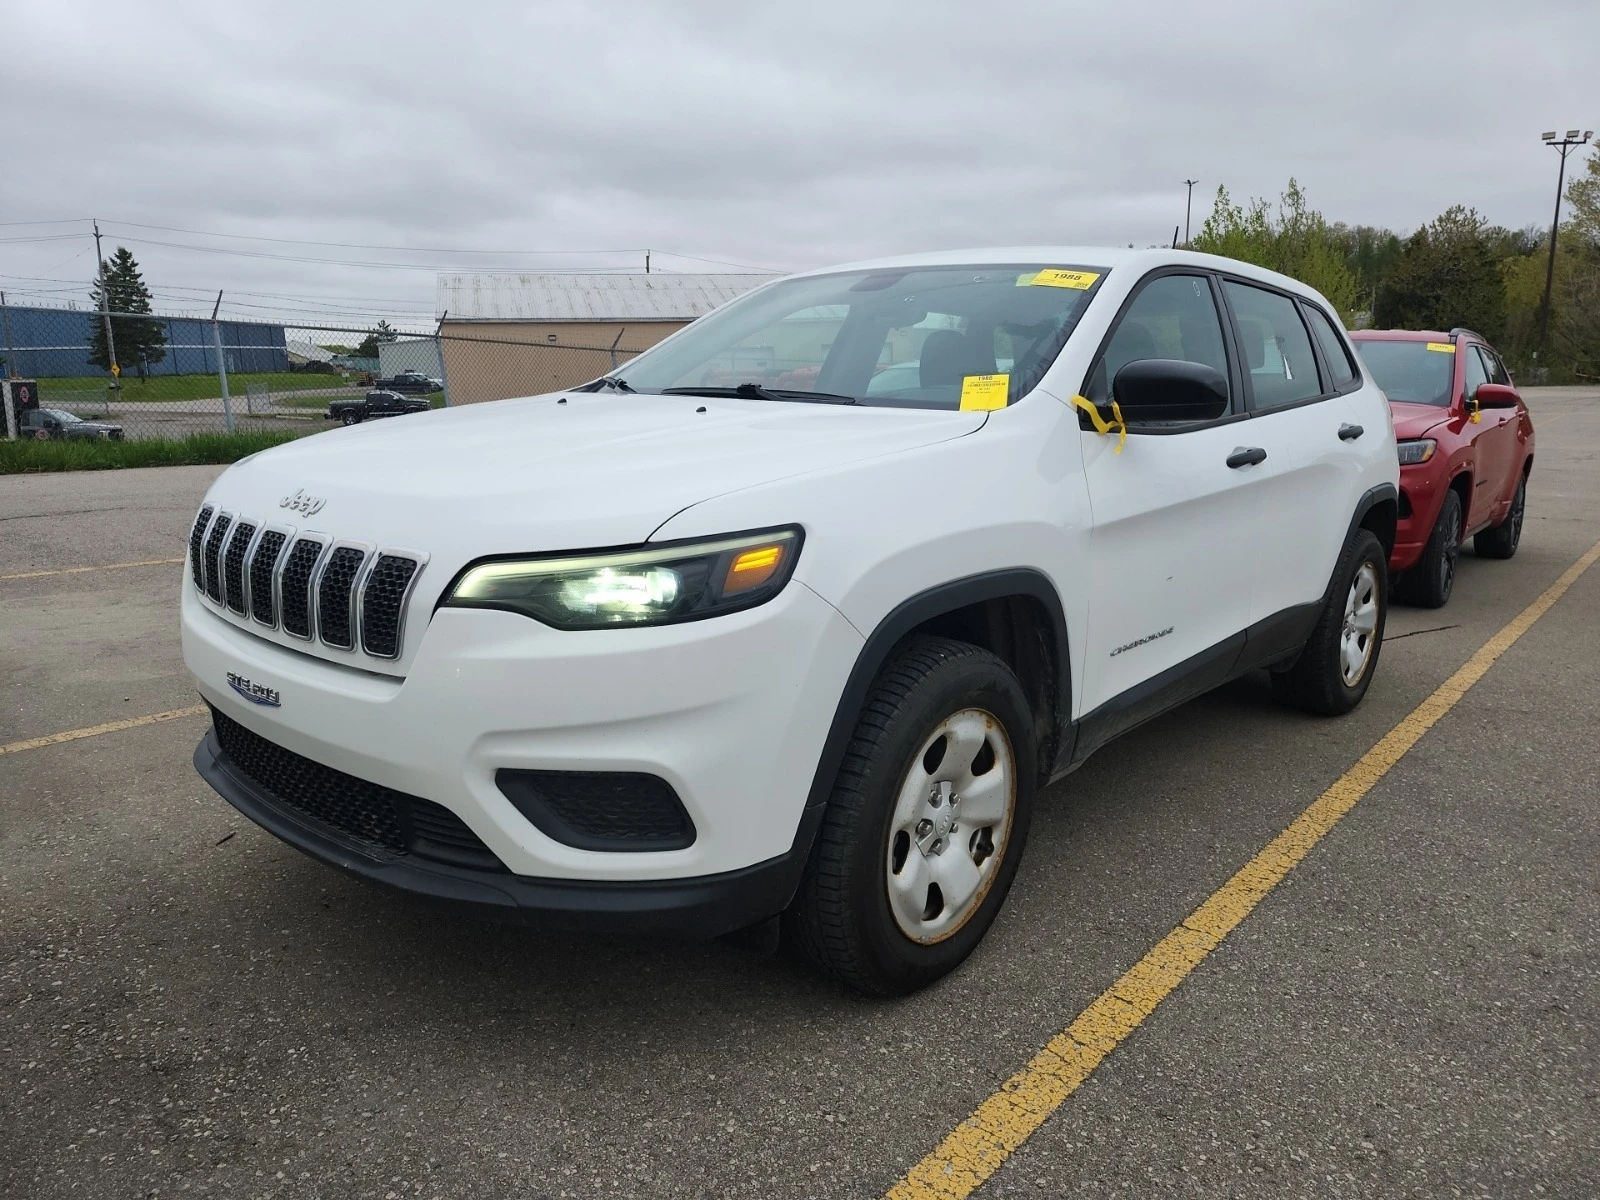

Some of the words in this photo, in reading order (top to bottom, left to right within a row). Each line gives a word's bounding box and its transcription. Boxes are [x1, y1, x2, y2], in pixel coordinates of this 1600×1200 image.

[1053, 273, 1082, 281] 1988
[279, 488, 327, 518] Jeep
[1109, 626, 1174, 656] CHEROKEE
